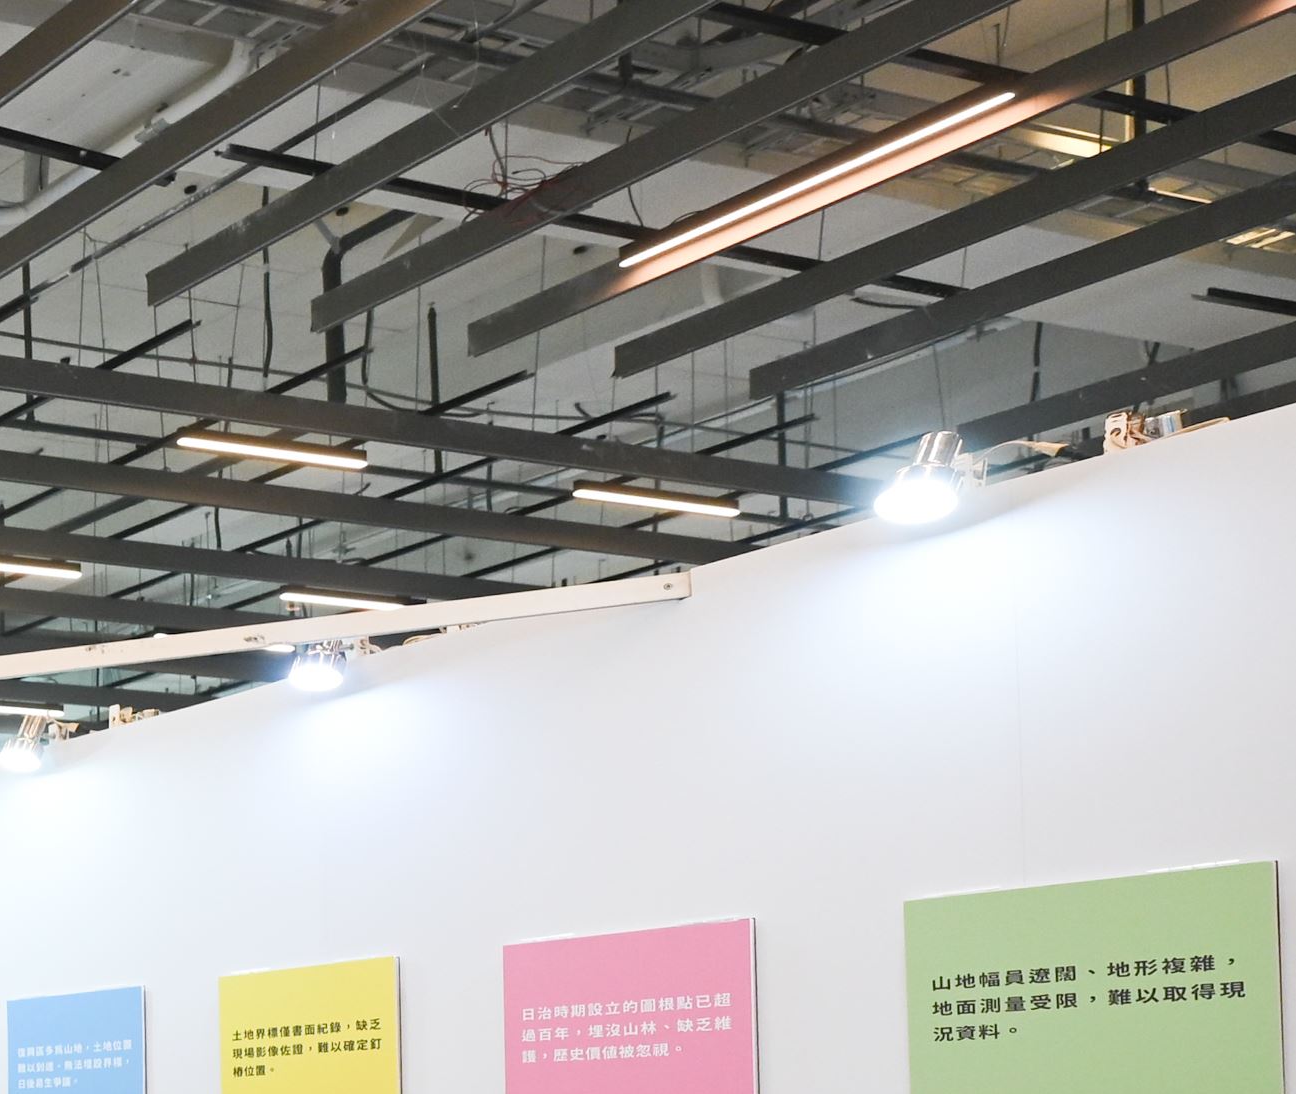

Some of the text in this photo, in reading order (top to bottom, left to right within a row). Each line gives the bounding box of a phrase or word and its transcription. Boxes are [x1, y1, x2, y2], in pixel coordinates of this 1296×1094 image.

[932, 954, 1236, 991] 山地幅員遼闊、地形複雜，
[522, 993, 731, 1021] 日治時期設立的圖根點已超
[932, 981, 1246, 1016] 地面測量受限，難以取得現
[232, 1018, 381, 1041] 土地界標僅書面紀錄，缺乏
[521, 1016, 732, 1043] 過百年，埋沒山林、缺乏維
[933, 1024, 1018, 1042] 況資料。
[232, 1038, 382, 1060] 現場影像佐證，難以確定釘
[522, 1043, 683, 1064] 護，歷史價值被忽視。
